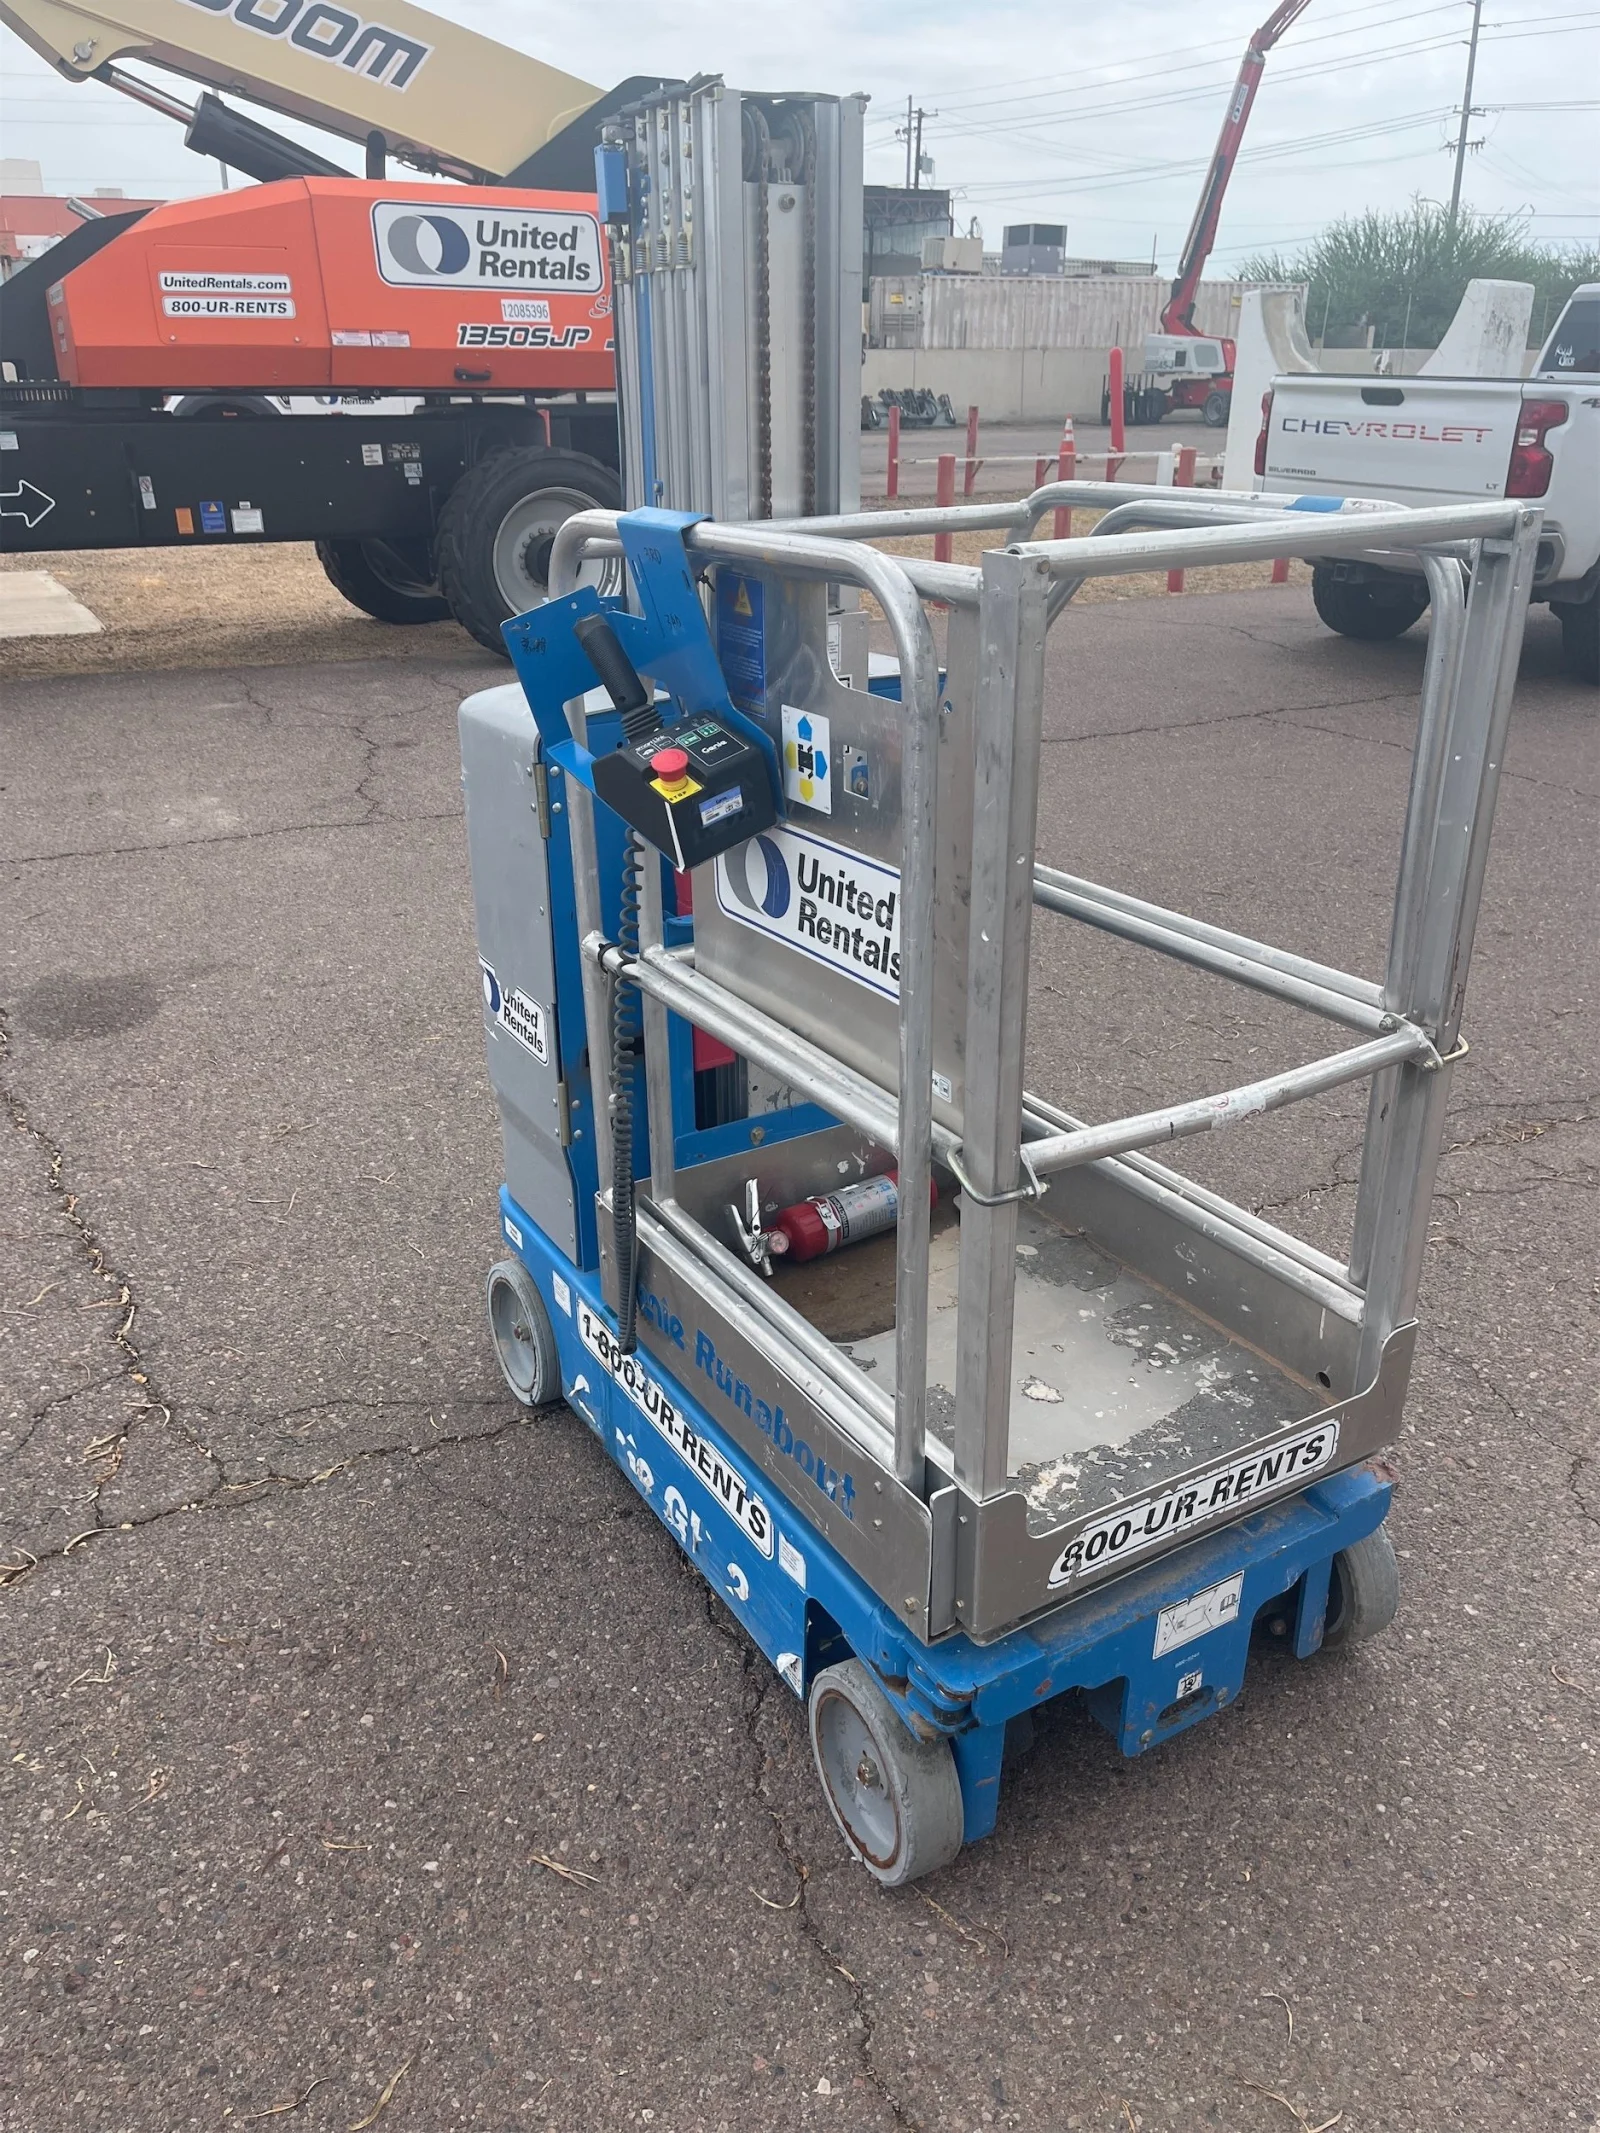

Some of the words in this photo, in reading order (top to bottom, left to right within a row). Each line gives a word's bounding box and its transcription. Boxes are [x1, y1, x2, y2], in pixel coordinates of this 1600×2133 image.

[182, 0, 429, 88] OOM
[476, 220, 578, 250] United
[479, 251, 591, 281] Rentals
[164, 276, 287, 290] UnitedRentals.com
[171, 301, 287, 314] 800-UR-RENTS
[502, 303, 549, 319] 12085396
[458, 325, 591, 348] 1350SJP
[1282, 418, 1493, 442] CHEVROLET
[1268, 466, 1316, 476] SILVERADO
[1486, 482, 1499, 490] LT
[701, 740, 728, 754] Genie
[669, 791, 687, 801] STOP
[797, 853, 896, 931] United
[798, 896, 900, 982] Rentals
[503, 1004, 543, 1054] Rentals
[583, 1314, 766, 1540] 1-800-UR-RENTS
[696, 1328, 856, 1520] Runabout
[1060, 1434, 1326, 1573] 800-UR-RENTS
